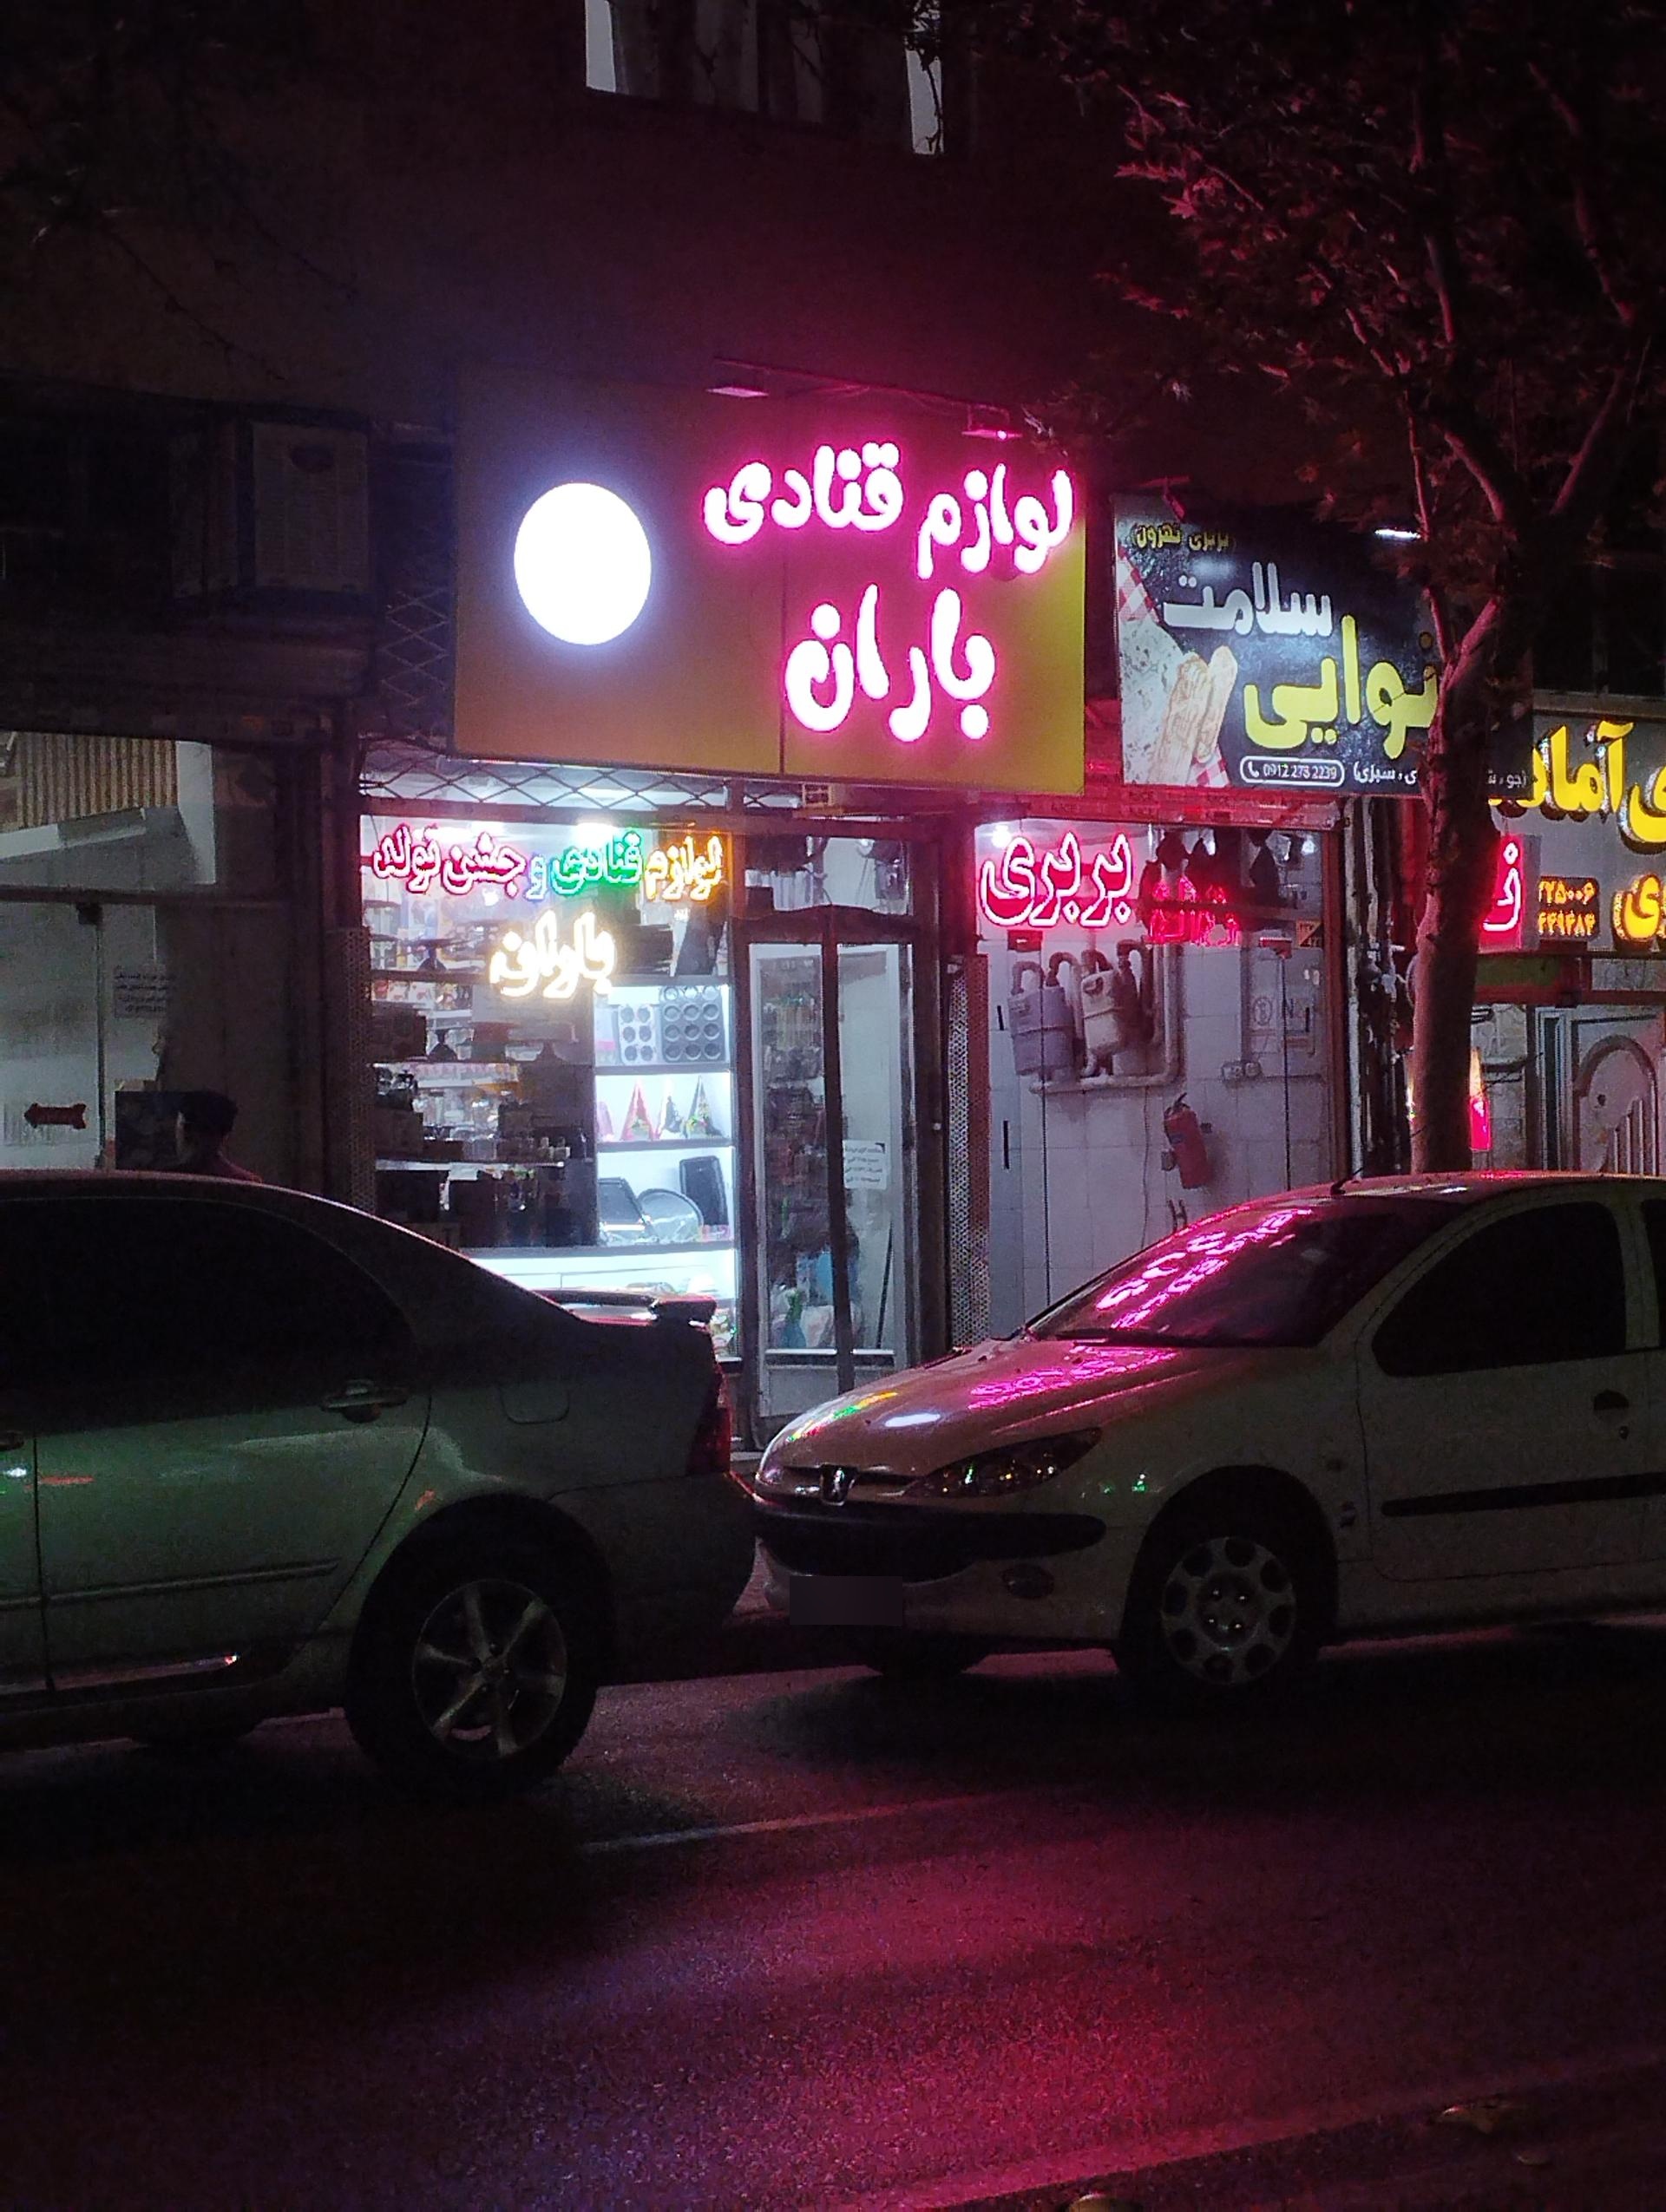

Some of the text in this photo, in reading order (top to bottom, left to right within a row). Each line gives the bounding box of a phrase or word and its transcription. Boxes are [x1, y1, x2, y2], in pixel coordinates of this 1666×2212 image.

[704, 442, 1075, 579] لوازم قنادی
[1164, 561, 1333, 637] سلامت
[785, 583, 996, 743] باران
[1243, 614, 1438, 759] نوایی
[372, 823, 724, 900] لوازم قنادی و جشن تولد
[981, 830, 1132, 927] بربری
[489, 909, 617, 999] باران
